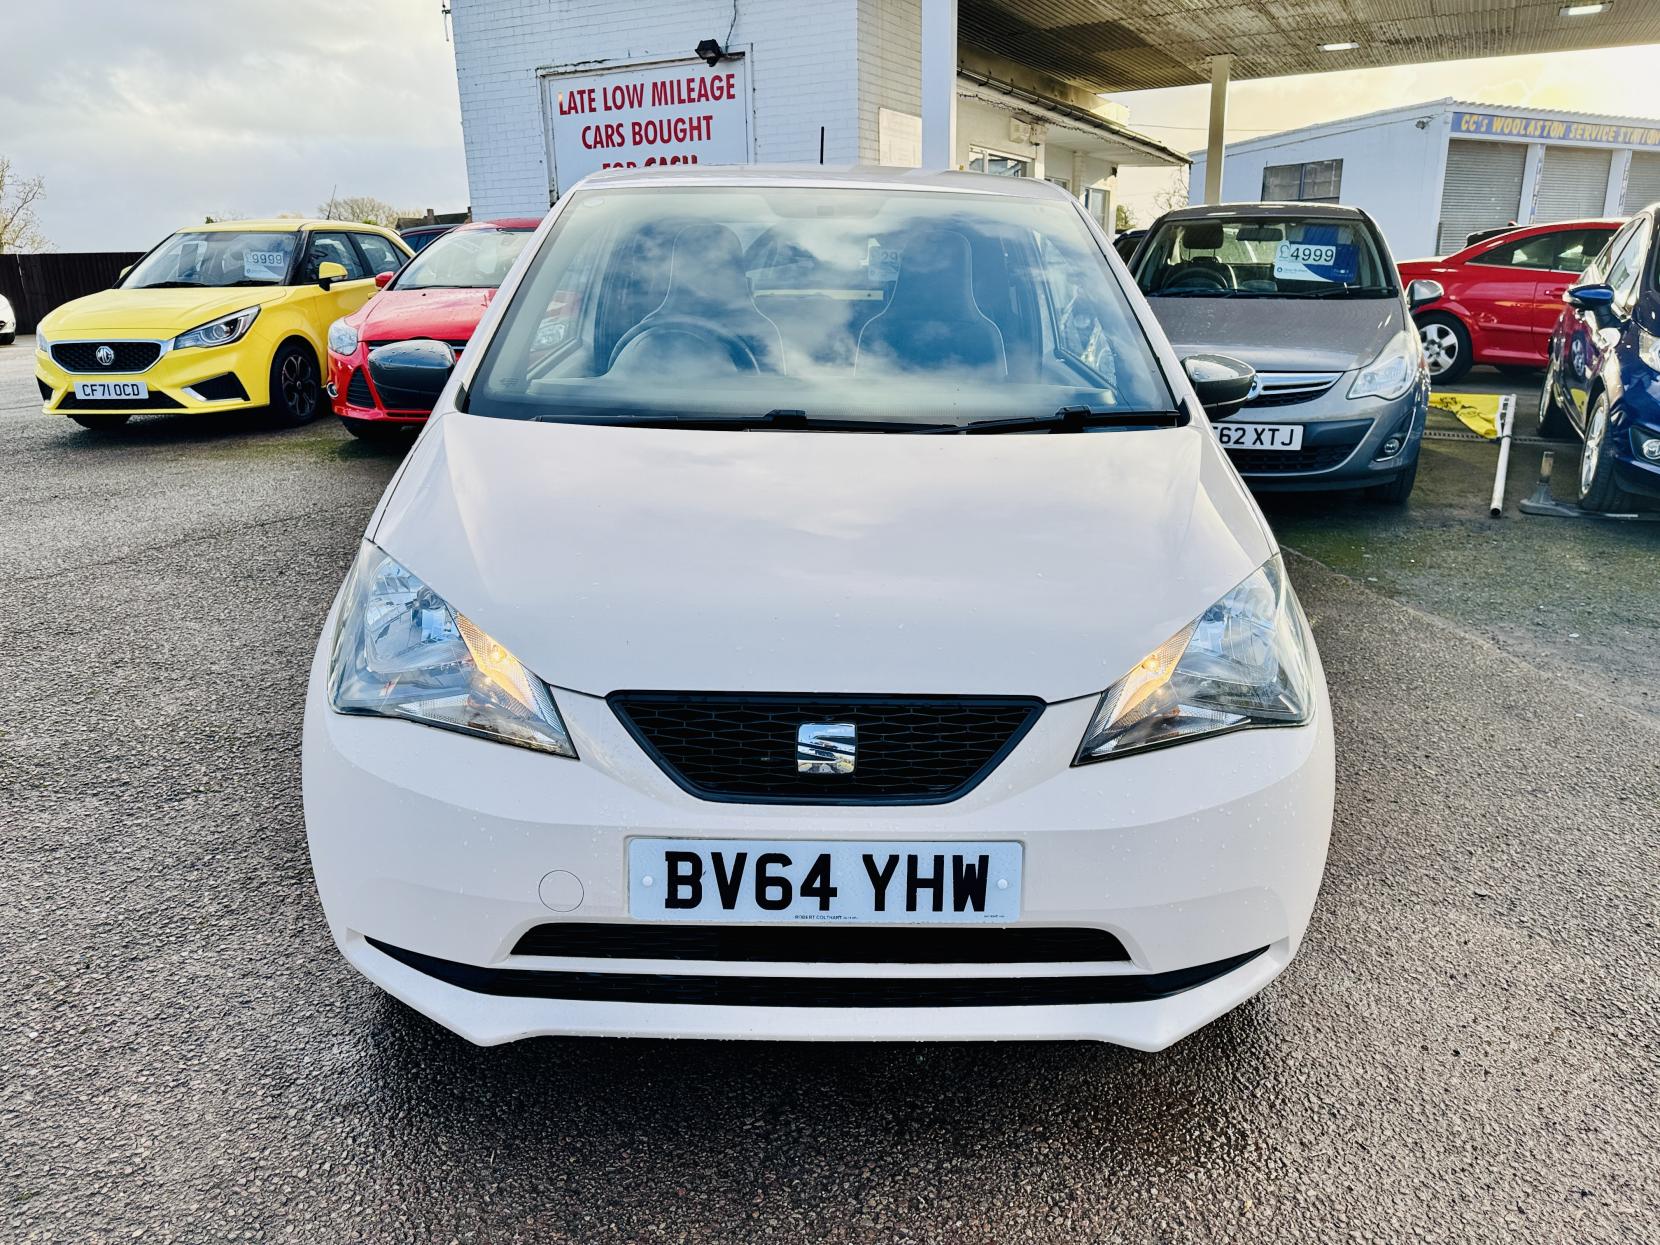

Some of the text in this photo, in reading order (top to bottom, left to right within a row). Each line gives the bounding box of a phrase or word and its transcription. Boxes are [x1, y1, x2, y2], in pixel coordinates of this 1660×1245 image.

[558, 73, 736, 116] LATE LOW MILEAGE
[581, 115, 713, 150] CARS BOUGHT
[1492, 116, 1565, 138] WOOLASTON
[1568, 122, 1616, 142] SERVICE
[81, 383, 140, 397] CF71 OCD
[1212, 426, 1294, 446] 62 XTJ
[664, 850, 990, 912] BV64 YHW
